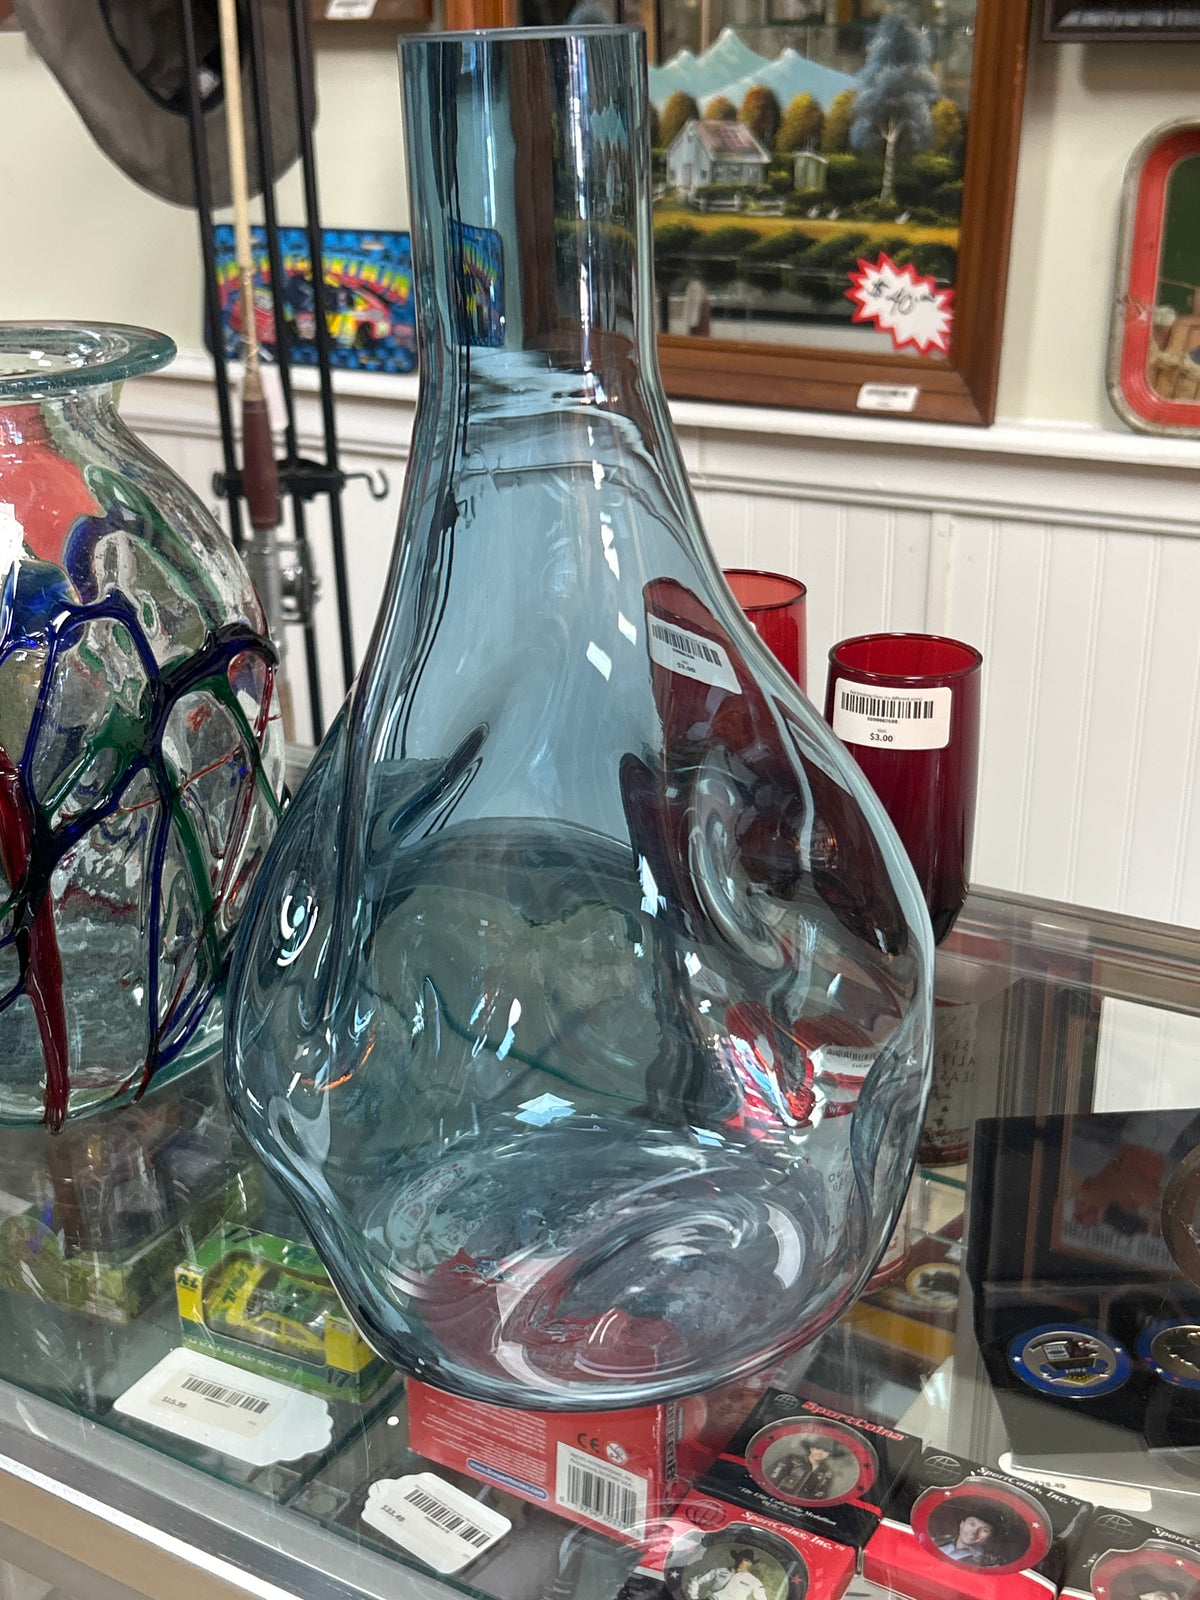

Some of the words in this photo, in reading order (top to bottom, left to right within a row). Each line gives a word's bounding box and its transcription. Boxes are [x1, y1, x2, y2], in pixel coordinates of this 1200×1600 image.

[870, 732, 893, 743] $3.00
[801, 1400, 905, 1441] SportCoins
[977, 1466, 1042, 1495] SportCoins,
[1046, 1491, 1068, 1504] Inc.
[741, 1510, 808, 1541] SportCoins,
[810, 1536, 833, 1550] Inc.
